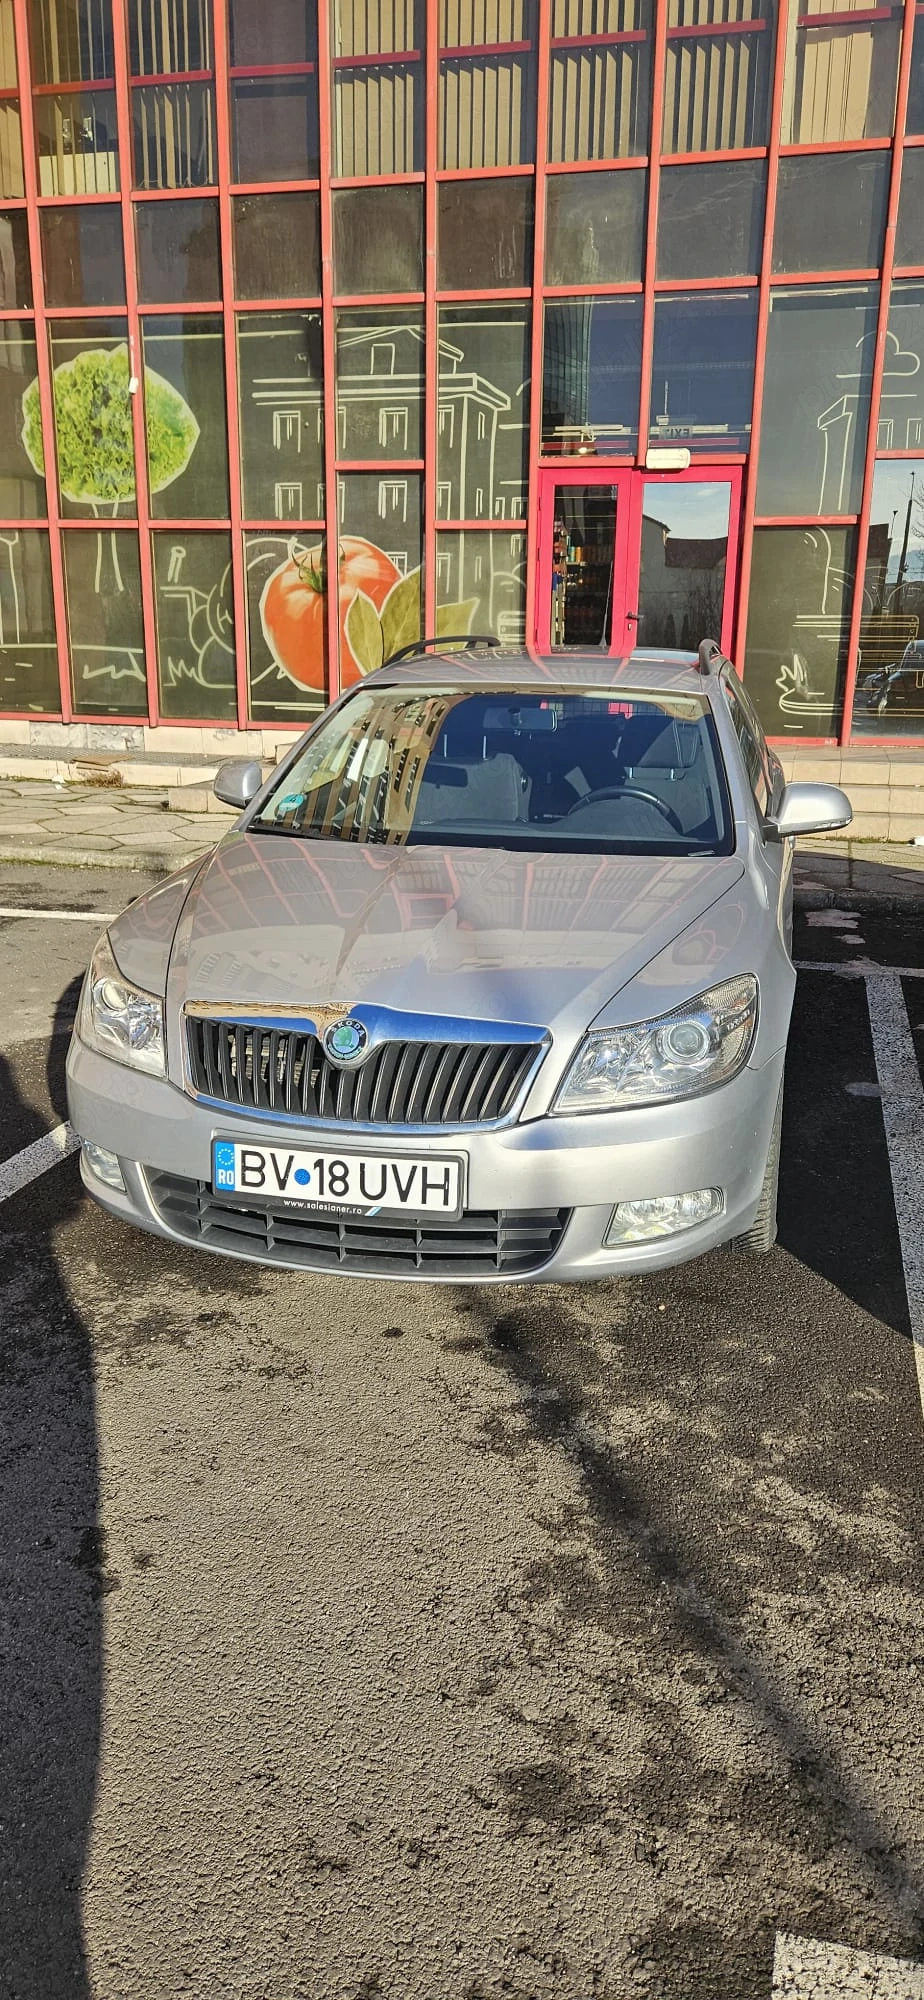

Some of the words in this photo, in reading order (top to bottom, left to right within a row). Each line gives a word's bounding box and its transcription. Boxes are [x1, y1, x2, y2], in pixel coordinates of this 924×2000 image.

[218, 1169, 234, 1185] RO
[240, 1149, 295, 1191] BV
[314, 1158, 350, 1197] 18
[359, 1162, 450, 1206] UVH
[283, 1199, 363, 1215] www.salesianer.ro
